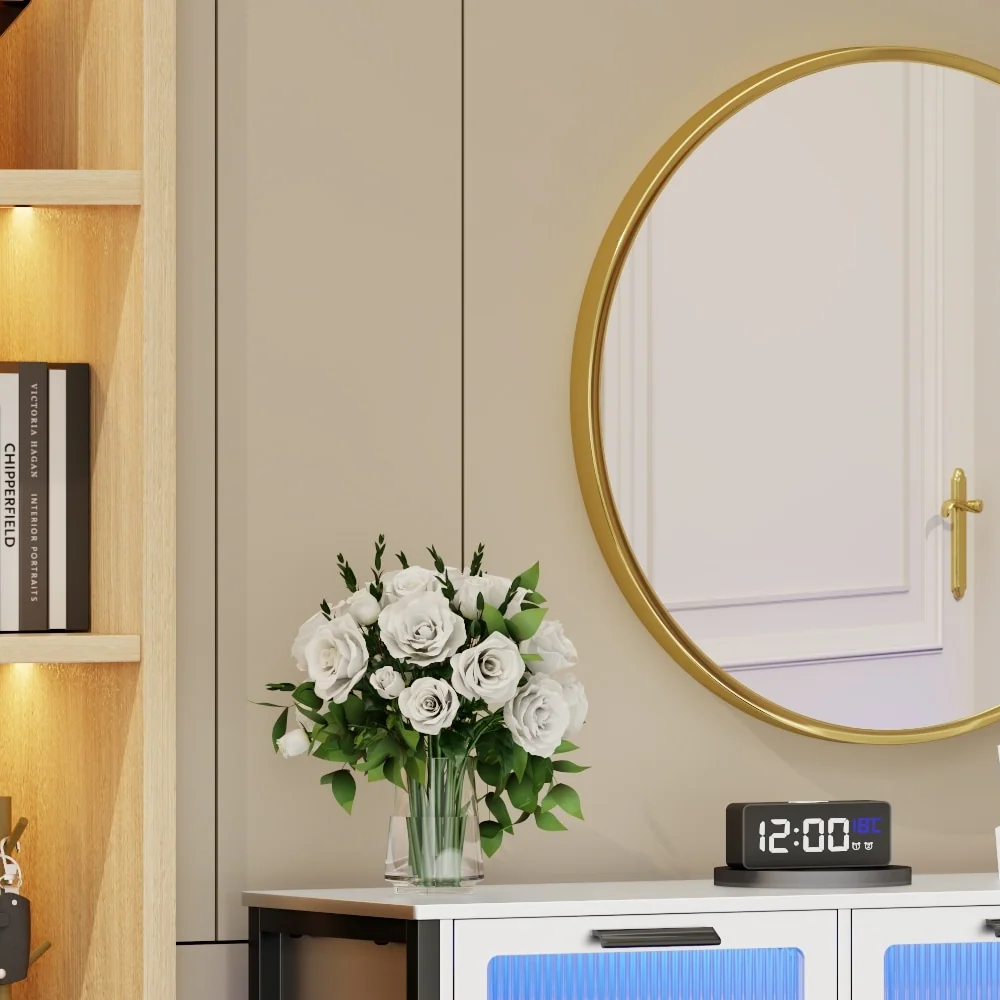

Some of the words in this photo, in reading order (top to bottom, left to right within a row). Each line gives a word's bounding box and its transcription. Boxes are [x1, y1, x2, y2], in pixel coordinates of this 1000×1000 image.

[30, 383, 38, 436] VICTORIA
[30, 441, 38, 478] HAGAN
[4, 443, 16, 548] CHIPPERFIELD
[30, 493, 38, 542] INTERIOR
[30, 546, 38, 602] PORTRAITS
[759, 817, 850, 854] 12:00
